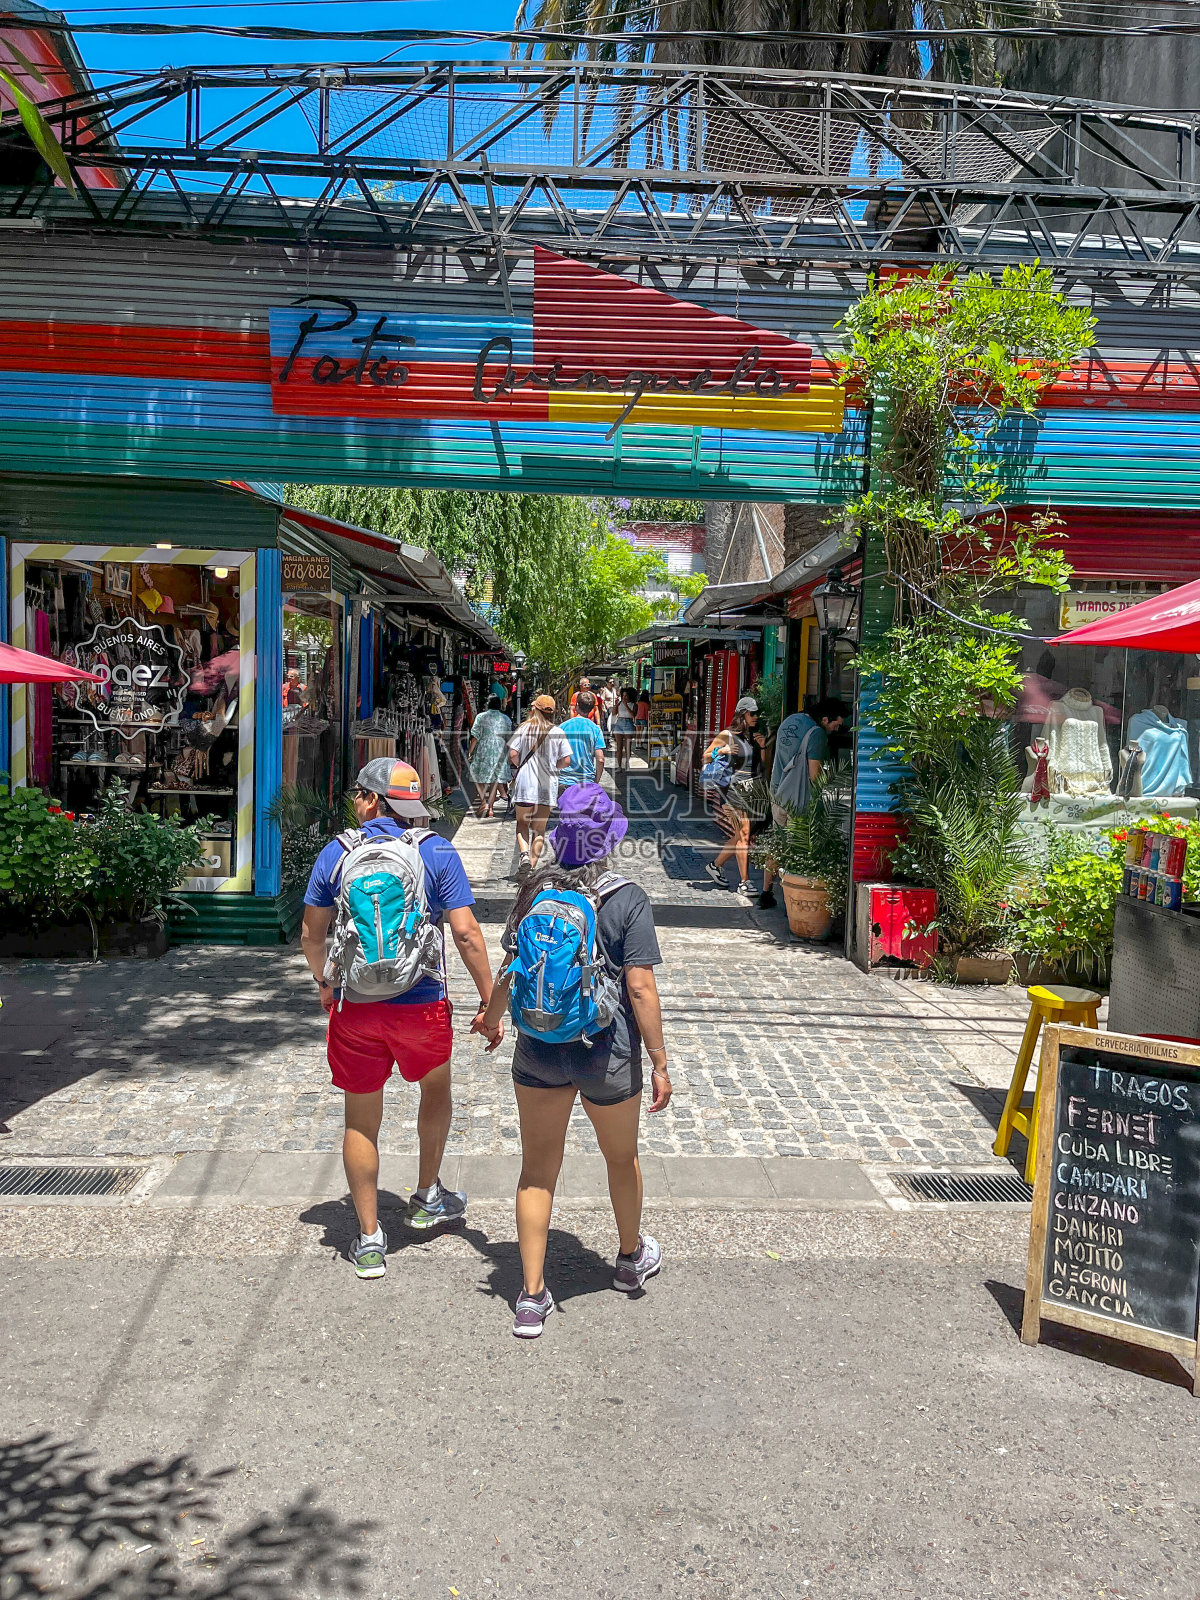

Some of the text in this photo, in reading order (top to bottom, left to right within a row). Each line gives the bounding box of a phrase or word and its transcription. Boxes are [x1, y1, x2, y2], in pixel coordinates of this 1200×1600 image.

[278, 294, 799, 441] Patio Quinquela
[283, 563, 331, 581] 878/882
[1076, 601, 1116, 613] MANOS
[93, 633, 165, 656] BUENOS AIRES
[92, 664, 169, 695] paez
[134, 704, 161, 720] ONDA
[1095, 1037, 1179, 1059] CERVECERIA QUILMES
[1088, 1061, 1191, 1111] TRAGOS
[1068, 1095, 1161, 1145] FERNET
[1116, 1140, 1173, 1175] LIBRE
[1057, 1162, 1148, 1199] CAMPARI
[1054, 1191, 1139, 1224] CINZANO
[1054, 1237, 1124, 1272] MOJITO
[1053, 1259, 1128, 1298] NEGRONI
[1048, 1278, 1135, 1318] GANCIA
